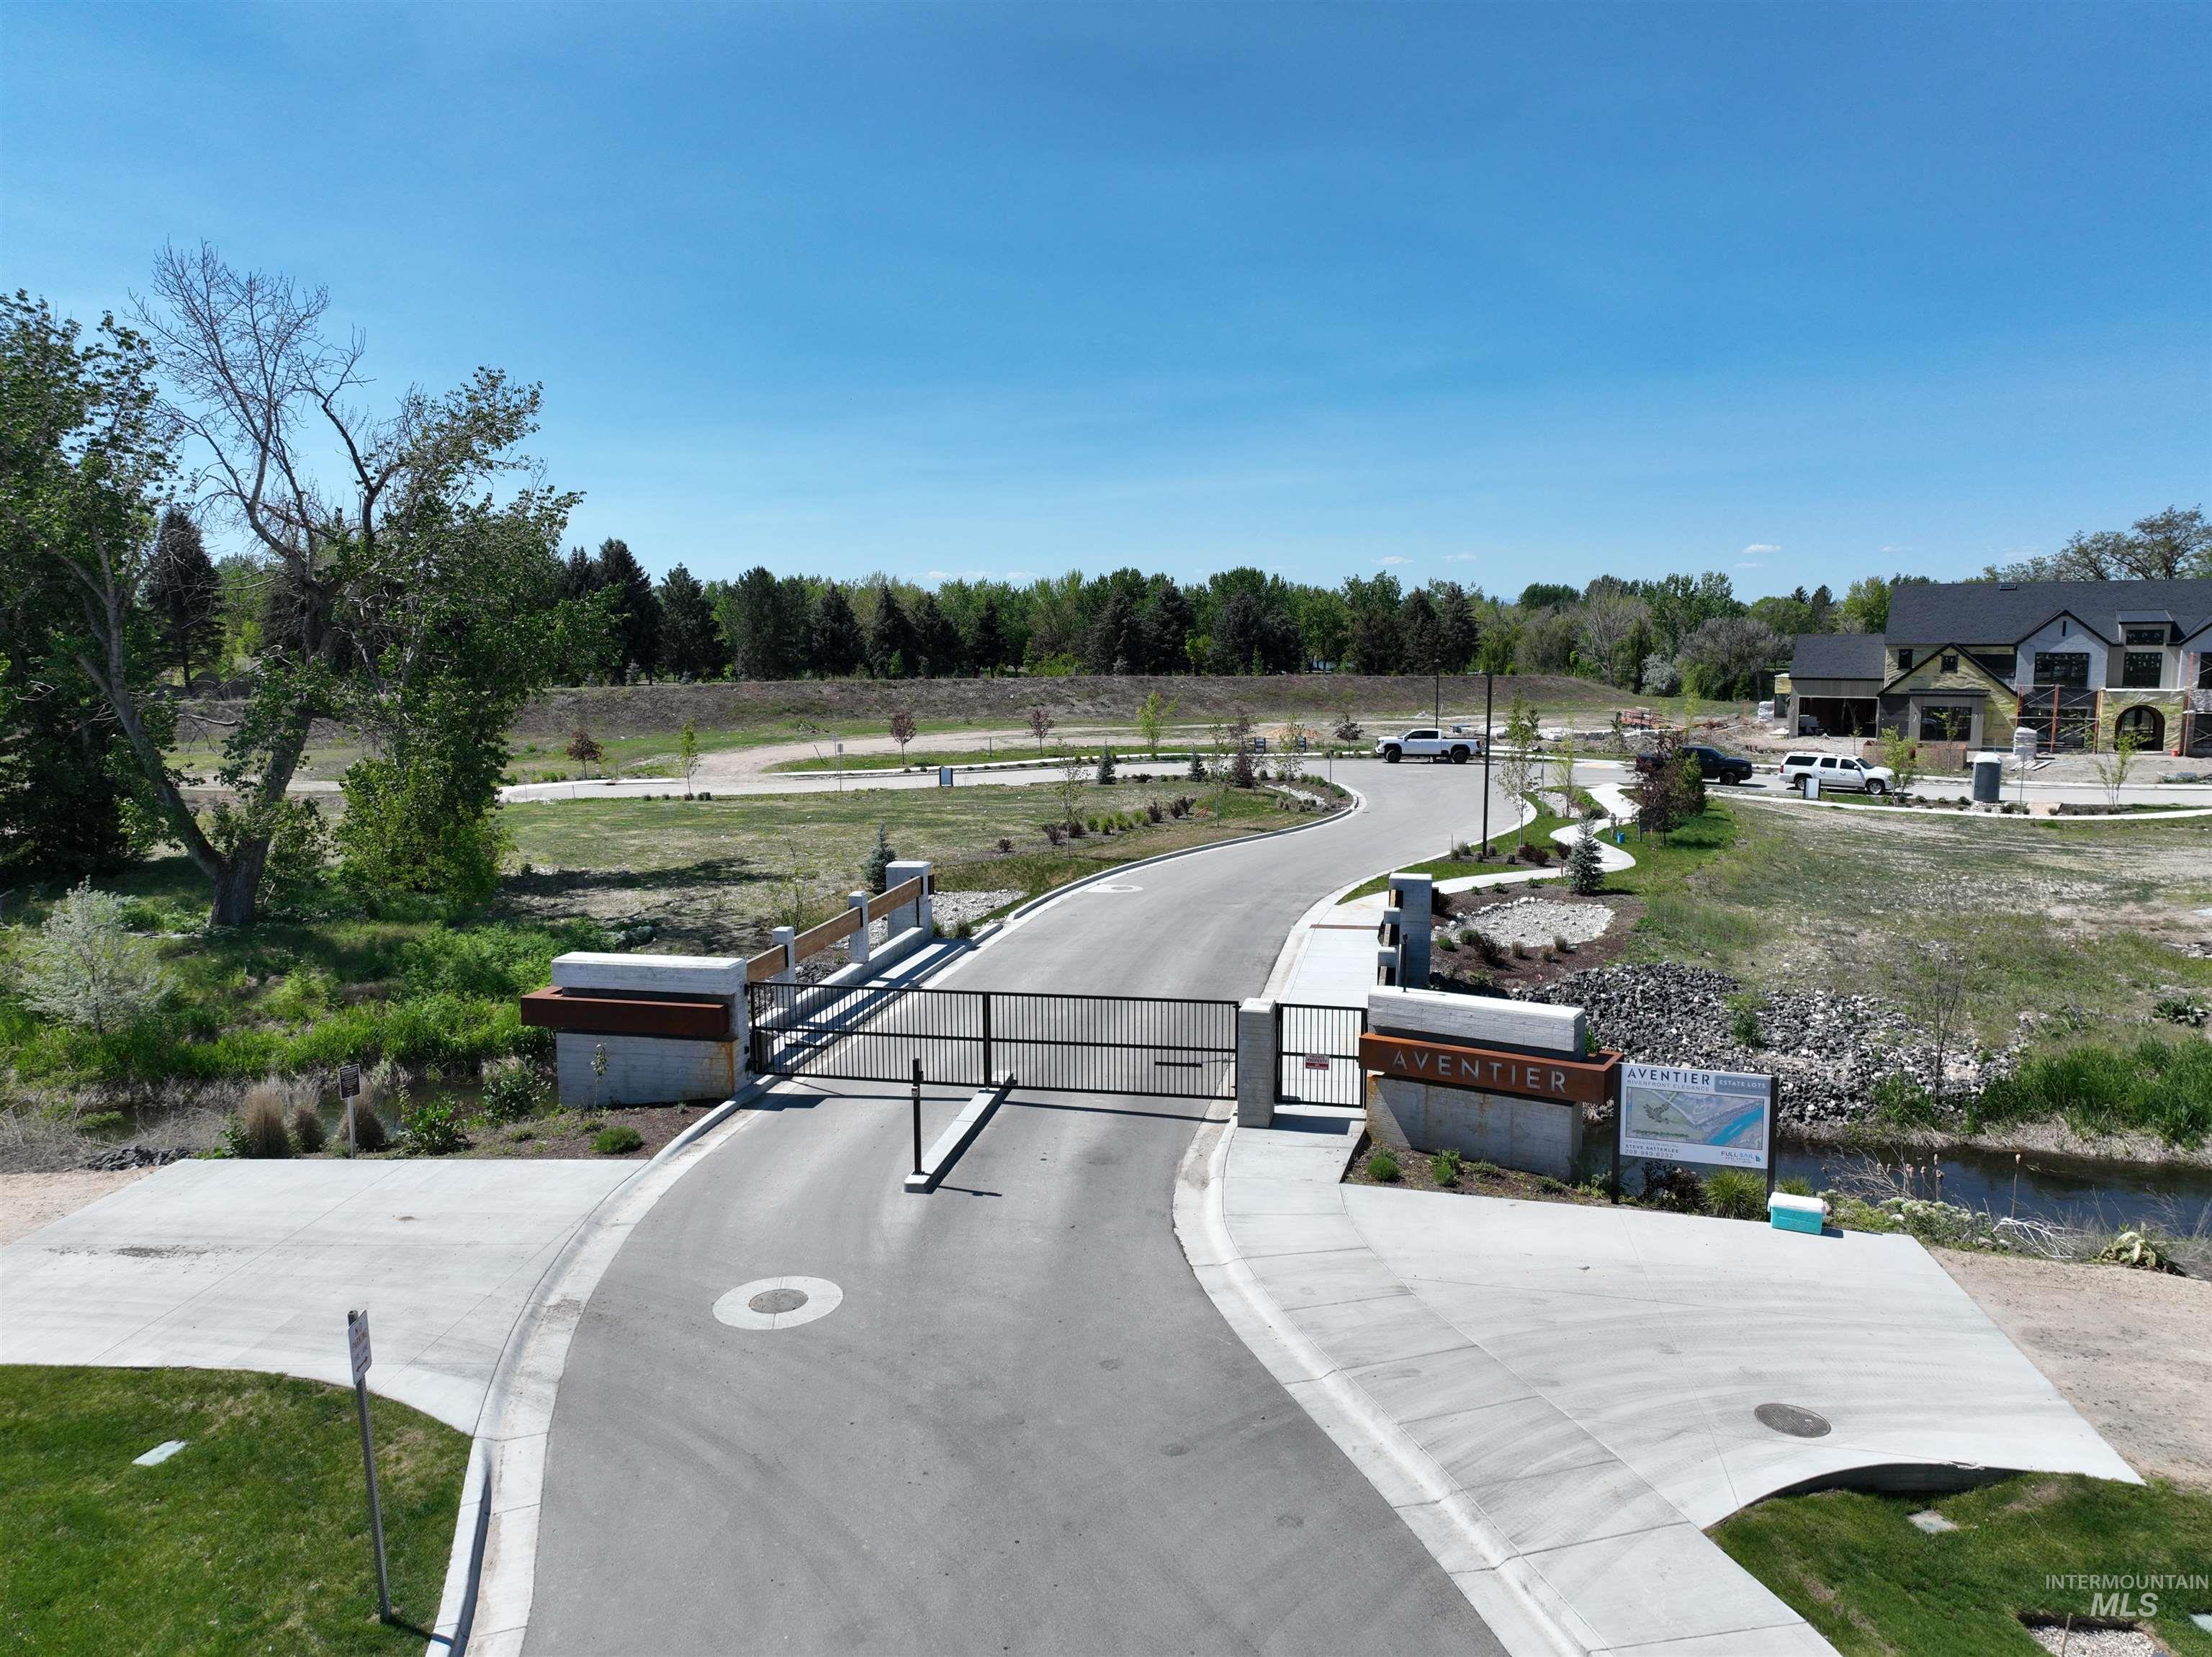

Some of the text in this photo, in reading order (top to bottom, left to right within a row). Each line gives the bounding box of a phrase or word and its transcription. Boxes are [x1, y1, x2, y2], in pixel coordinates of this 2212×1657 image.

[1393, 1049, 1566, 1094] AVENTIER
[1627, 1068, 1710, 1085] AVENTIER
[355, 1322, 363, 1336] NO
